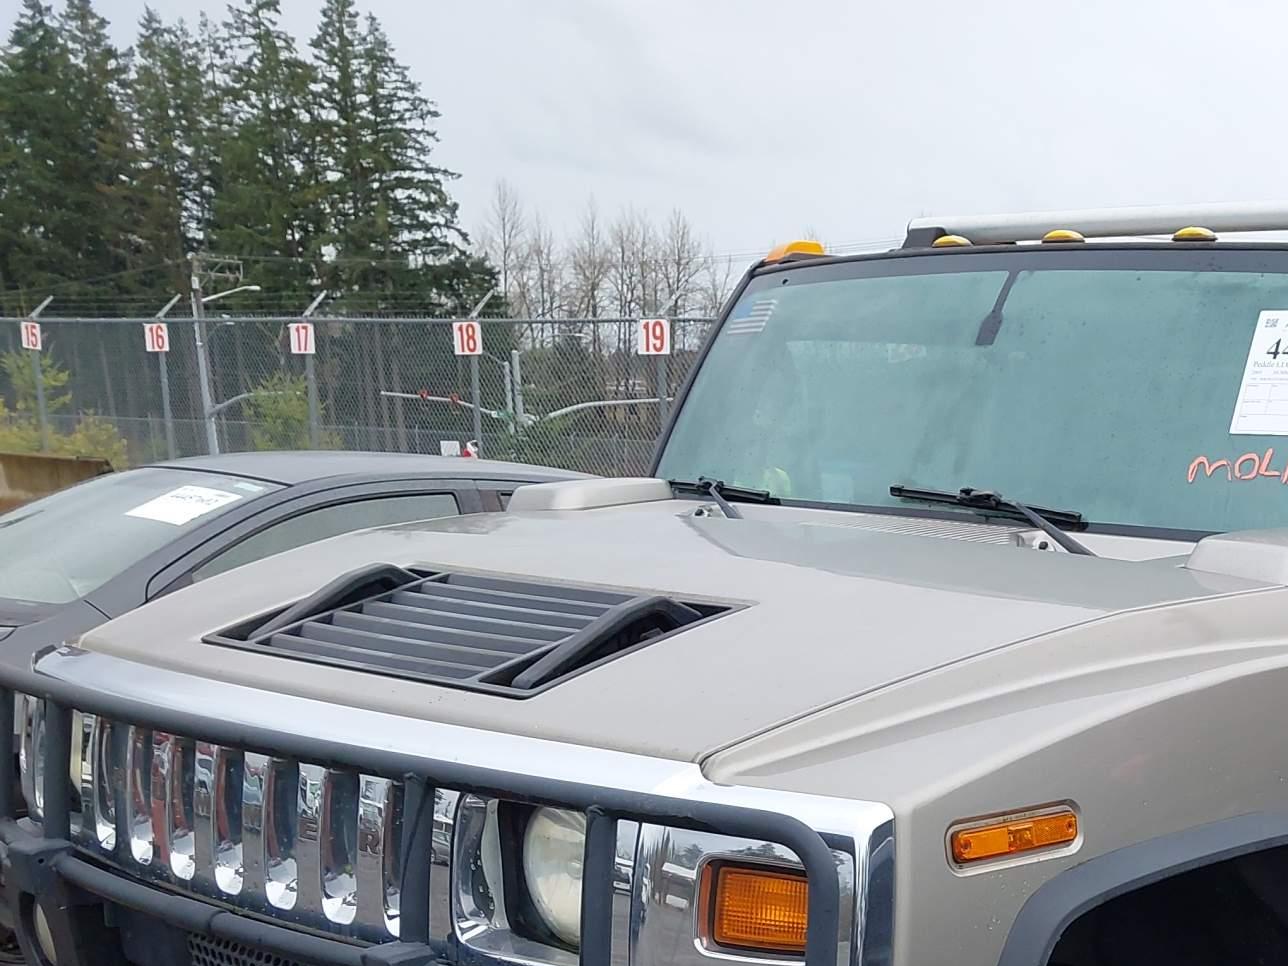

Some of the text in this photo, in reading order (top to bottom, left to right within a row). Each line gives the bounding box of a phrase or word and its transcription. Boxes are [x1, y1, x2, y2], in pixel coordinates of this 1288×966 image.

[25, 324, 38, 348] 15
[149, 325, 165, 350] 16
[295, 325, 309, 352] 17
[458, 323, 477, 353] 18
[642, 320, 665, 353] 19
